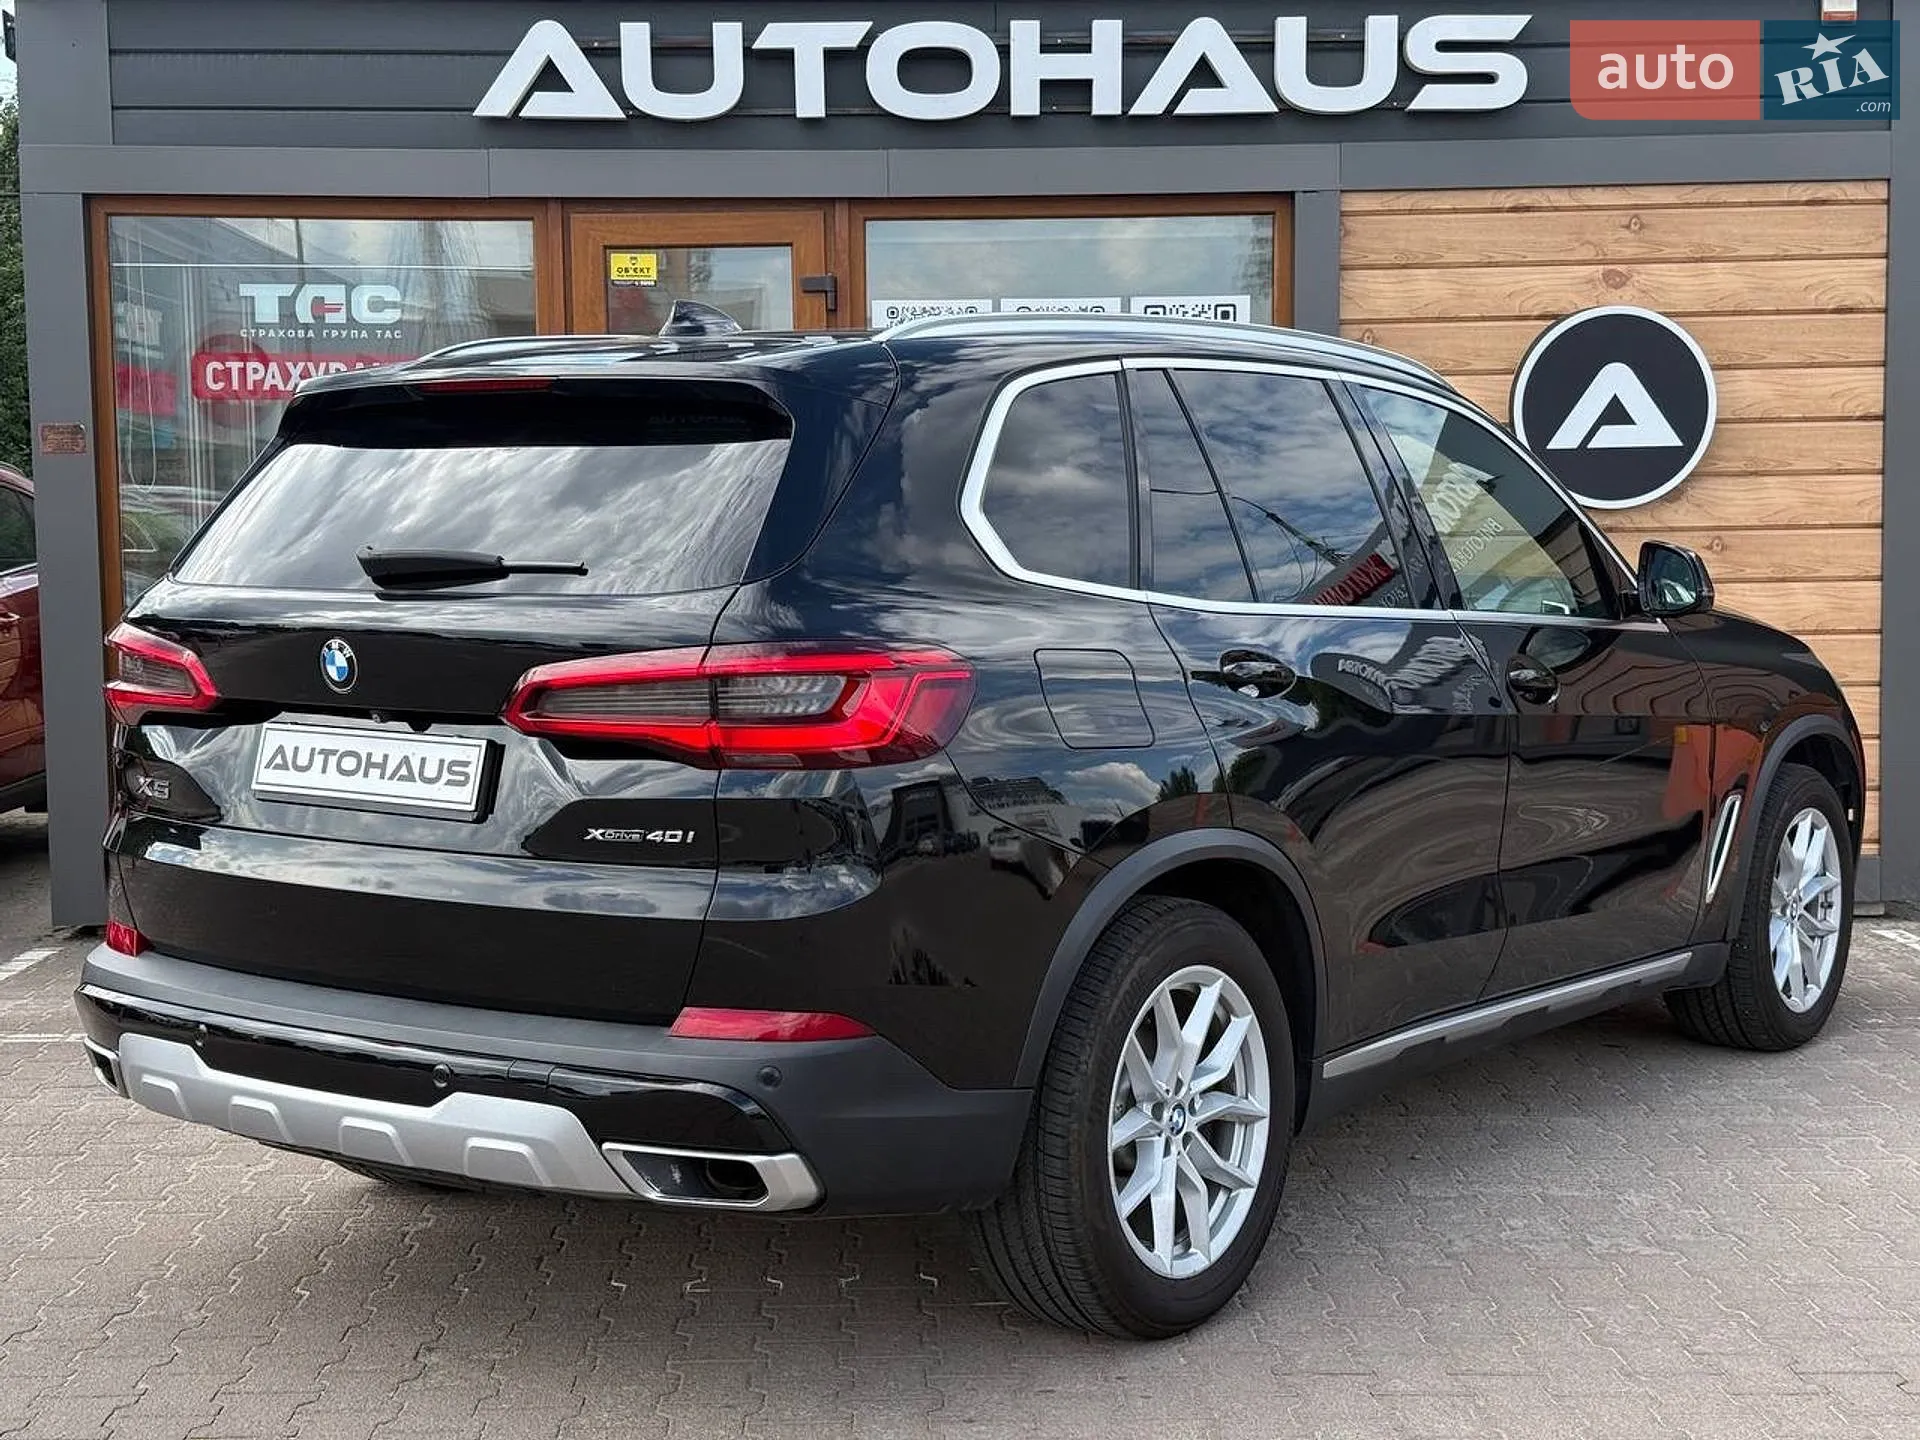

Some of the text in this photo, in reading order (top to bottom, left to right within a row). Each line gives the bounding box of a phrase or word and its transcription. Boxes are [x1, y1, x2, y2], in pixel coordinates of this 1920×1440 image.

[473, 15, 1532, 119] AUTOHAUS
[240, 328, 402, 339] СТРАХОВА ГРУПА ТАС
[264, 743, 472, 788] AUTOHAUS
[135, 775, 169, 799] X5
